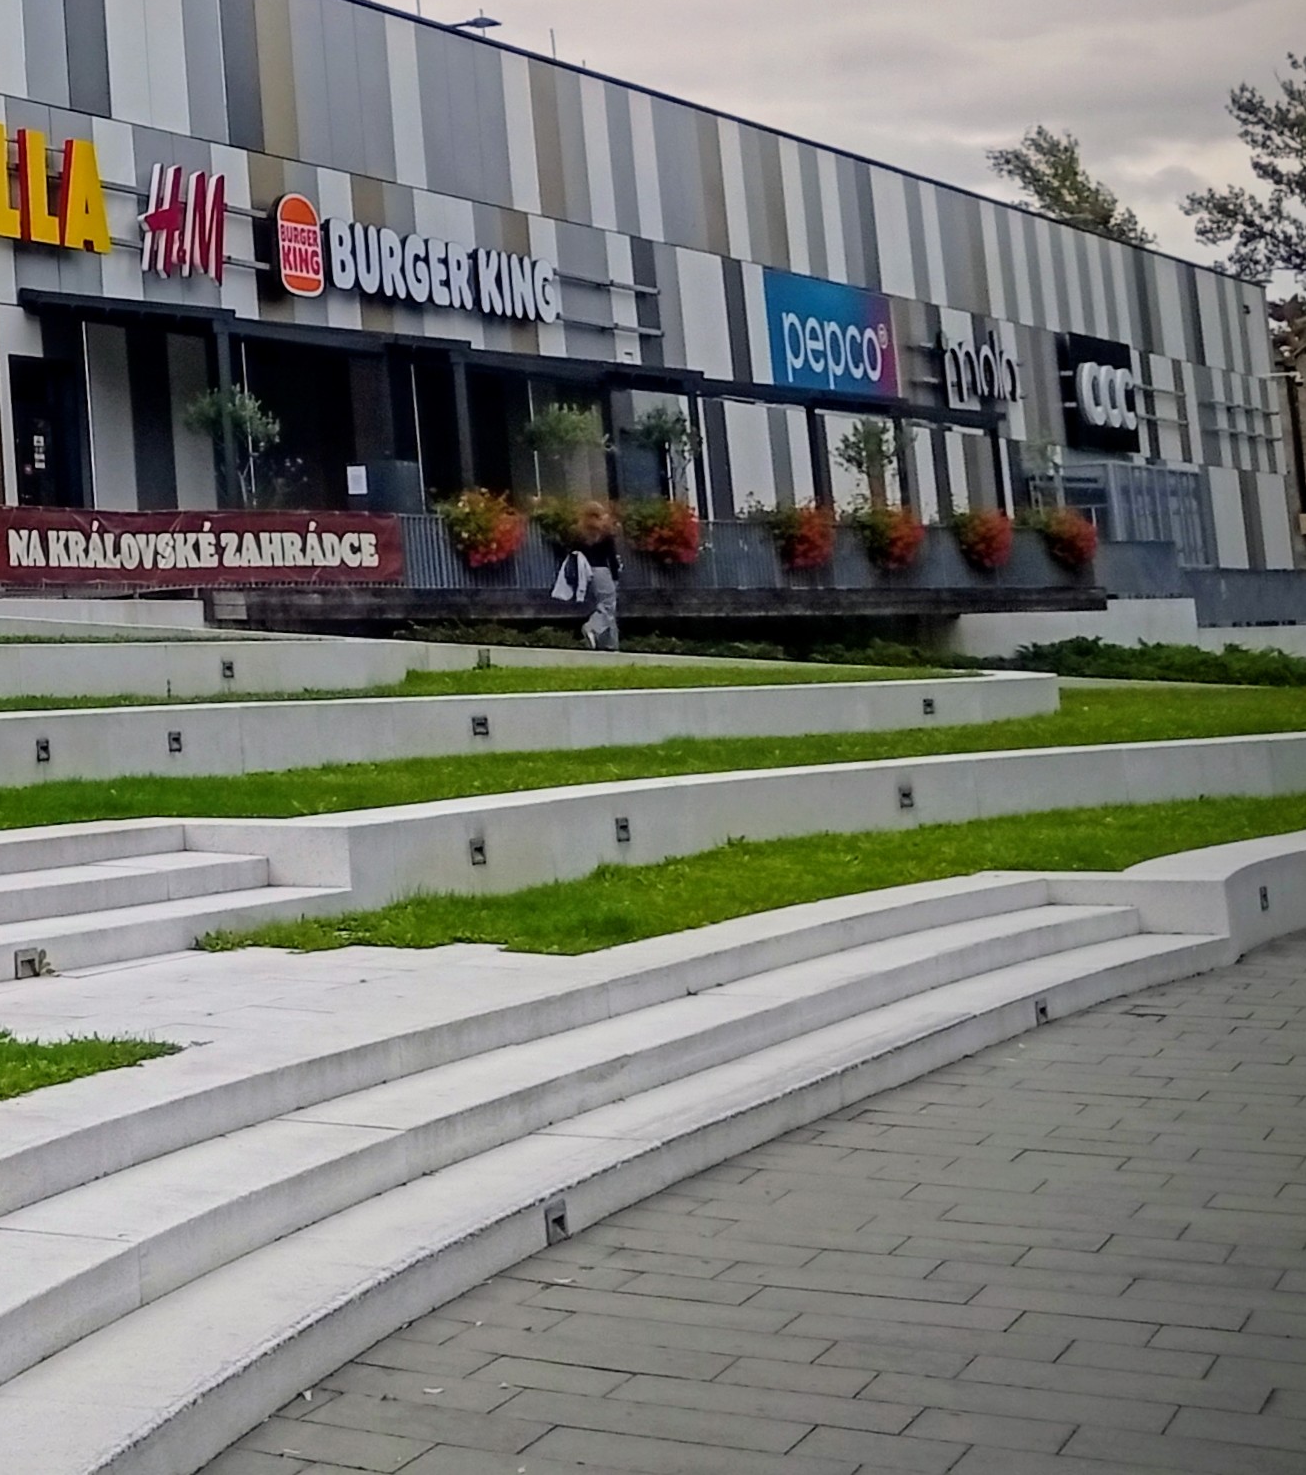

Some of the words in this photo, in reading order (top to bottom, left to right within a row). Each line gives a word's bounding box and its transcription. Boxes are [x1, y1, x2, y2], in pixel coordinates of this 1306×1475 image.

[138, 162, 226, 286] H&M
[280, 223, 319, 248] BURGER
[282, 244, 321, 276] KING
[326, 217, 473, 311] BURGER
[476, 247, 559, 324] KING
[1076, 362, 1138, 431] CCC
[7, 528, 47, 567] NA
[46, 520, 219, 569] KRÁLOVSKÉ
[220, 520, 379, 568] ZAHRÁDCE
